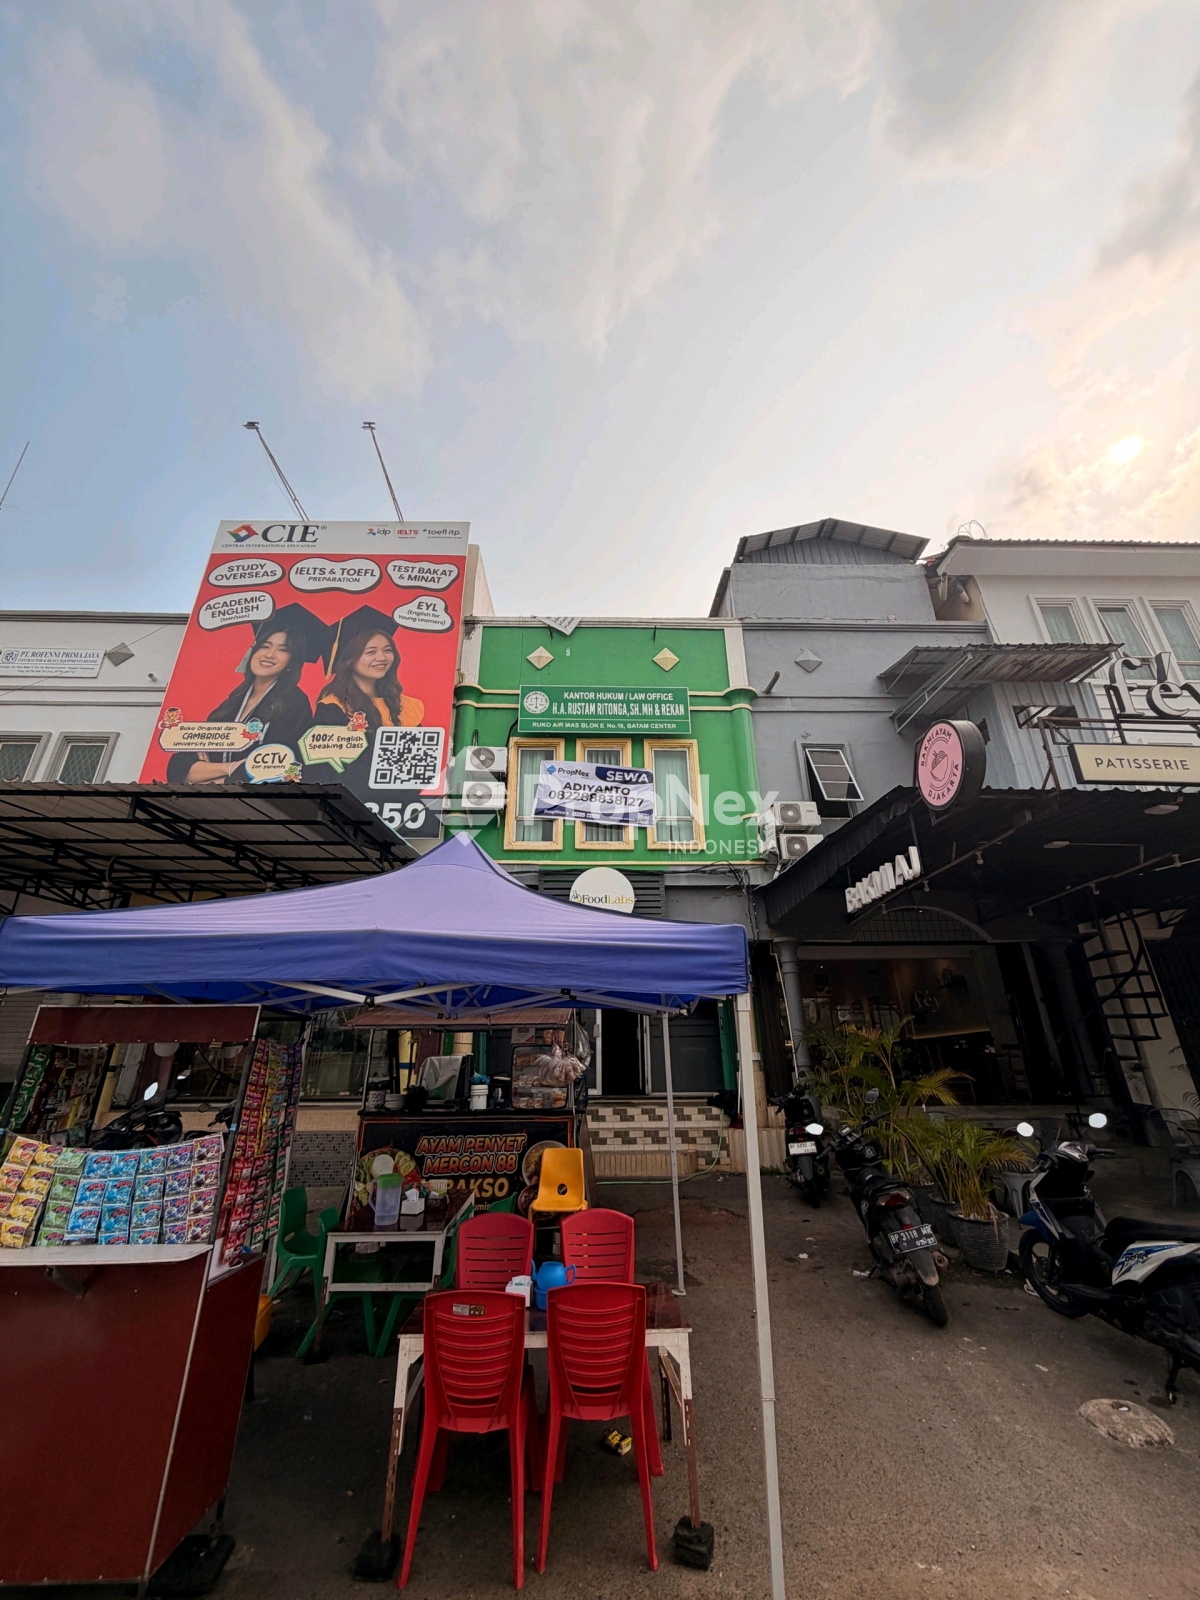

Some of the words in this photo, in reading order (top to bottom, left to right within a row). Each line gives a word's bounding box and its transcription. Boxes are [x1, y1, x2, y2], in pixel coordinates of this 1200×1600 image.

[376, 528, 391, 536] idp
[227, 563, 267, 573] STUDY
[295, 567, 327, 575] IELTS
[340, 568, 377, 577] TOEFL
[392, 565, 417, 573] TEST
[417, 567, 454, 577] BAKAT
[214, 570, 277, 581] OVERSEAS
[407, 574, 442, 584] MINAT
[204, 595, 267, 612] ACADEMIC
[417, 601, 438, 612] EYL
[211, 604, 259, 619] ENGLISH
[407, 609, 431, 618] (English
[398, 614, 417, 623] Young
[417, 617, 446, 626] Learners)
[61, 651, 83, 659] PRIMA
[563, 691, 595, 700] KANTOR
[596, 692, 624, 700] HUKUM
[646, 693, 674, 701] OFFICE
[567, 702, 596, 715] RUSTAM
[654, 704, 661, 716] &
[661, 703, 685, 716] REKAN
[182, 732, 231, 740] CAMBRIDGE
[311, 733, 334, 743] 100%
[336, 735, 363, 743] English
[308, 742, 344, 750] Speaking
[920, 733, 935, 767] BAKMI
[935, 728, 952, 740] AYAM
[253, 752, 288, 764] CCTV
[1094, 757, 1190, 770] PATISSERIE
[558, 767, 589, 777] PropNex
[606, 770, 649, 783] SEWA
[928, 763, 960, 801] DJAKARTA
[563, 782, 631, 796] ADIYANTO
[548, 789, 644, 808] 082288838127
[582, 894, 634, 905] FoodLabs
[416, 1135, 462, 1155] AYAM
[463, 1133, 527, 1154] PENYET
[423, 1154, 495, 1176] MERCON
[495, 1153, 518, 1174] 88
[890, 1233, 900, 1244] BP
[900, 1229, 919, 1242] 3118
